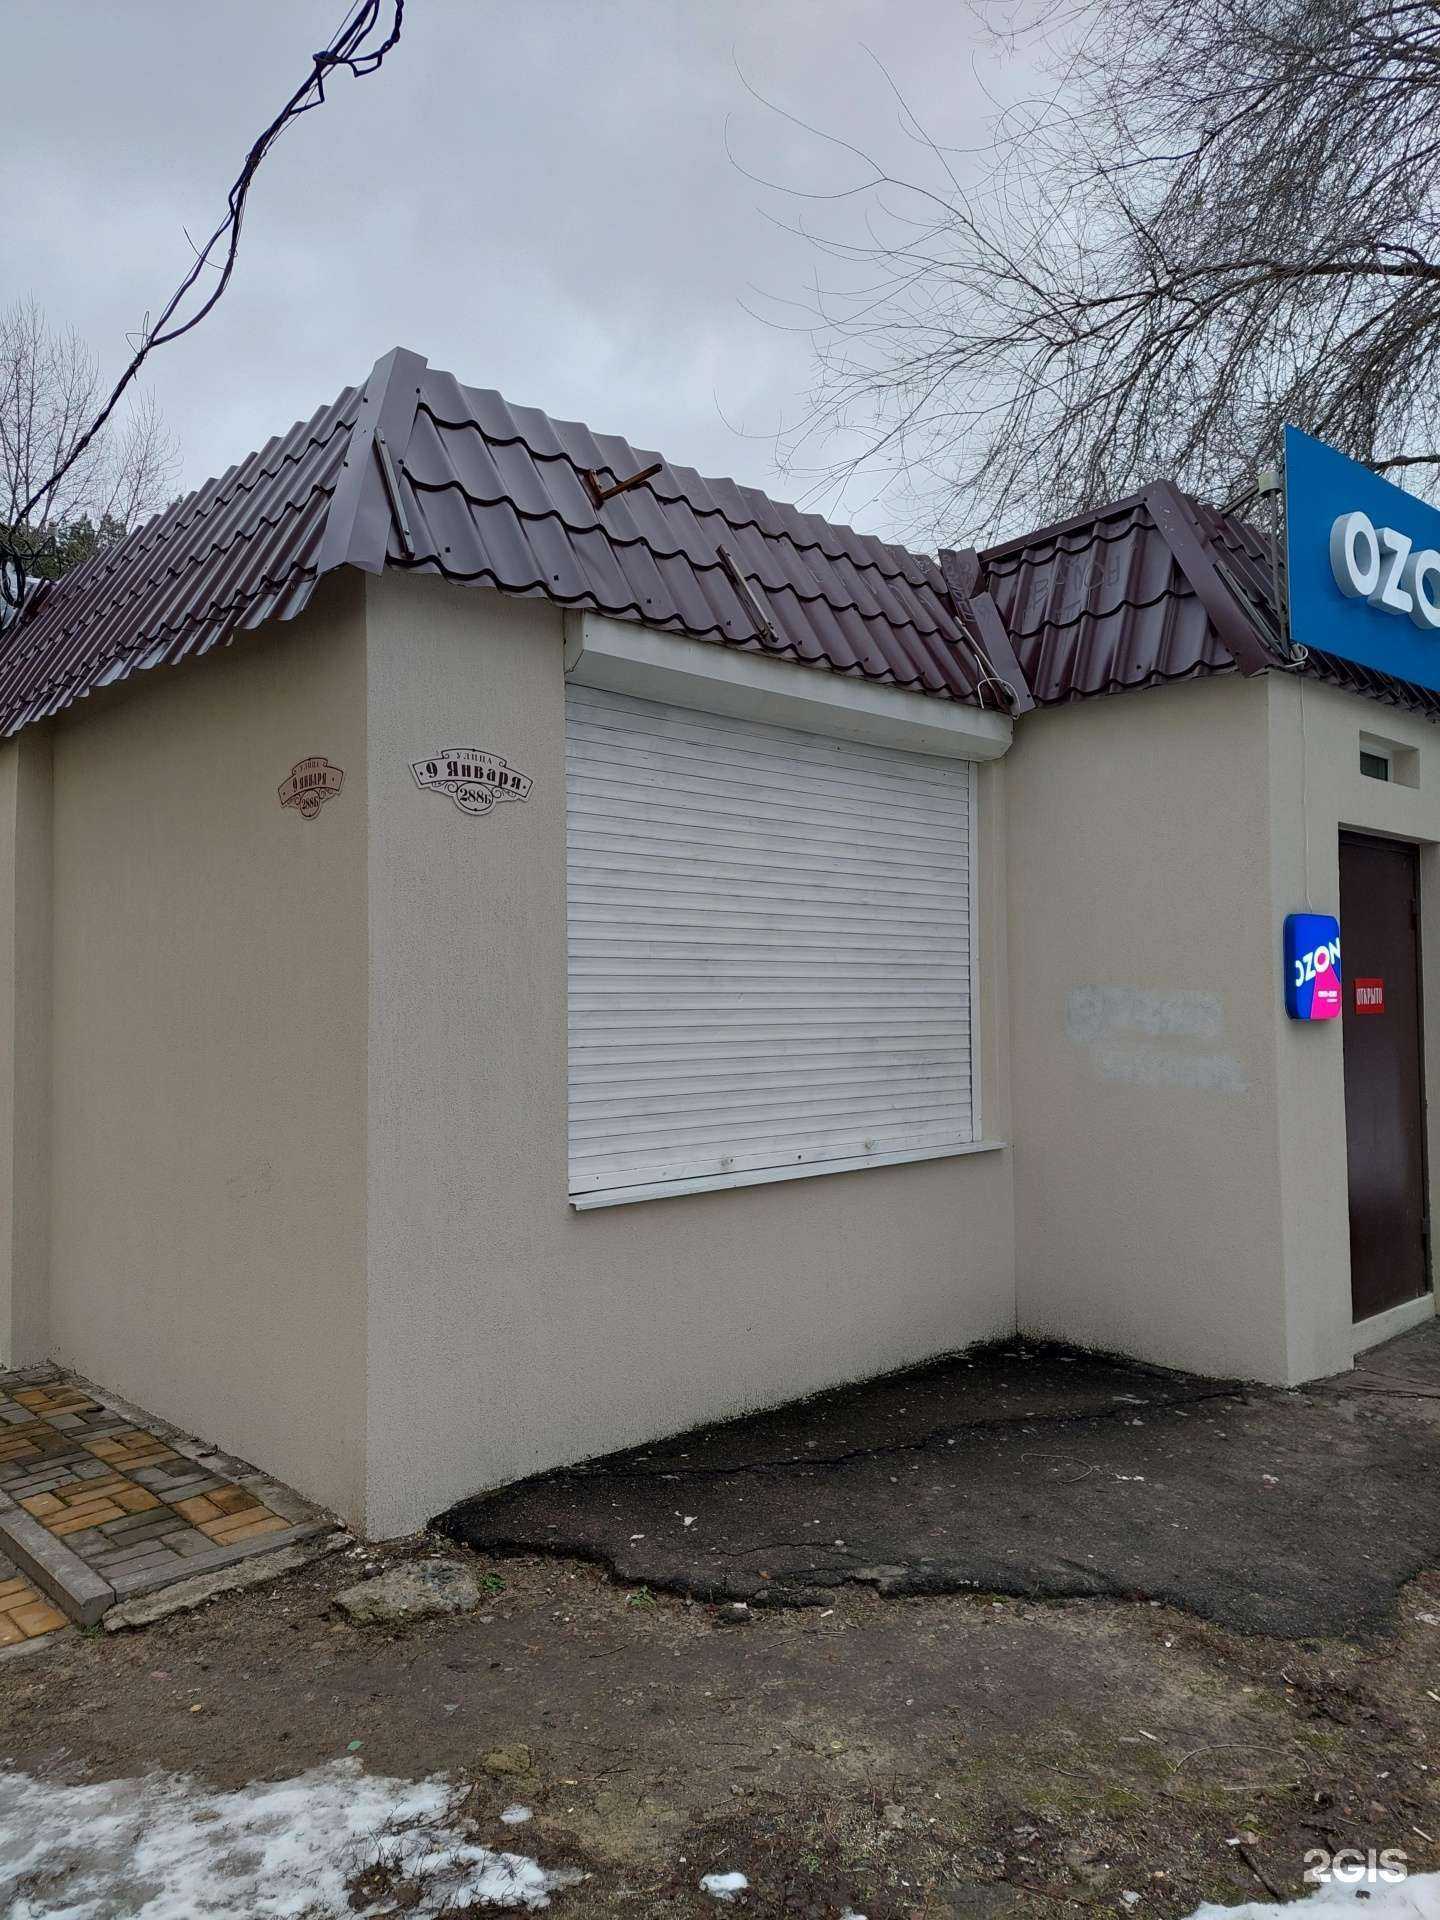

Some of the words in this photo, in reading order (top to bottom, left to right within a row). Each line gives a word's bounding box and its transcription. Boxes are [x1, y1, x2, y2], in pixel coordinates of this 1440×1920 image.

[425, 761, 438, 779] 9
[446, 760, 522, 790] Января
[1356, 987, 1383, 1005] ОТКРЫТО
